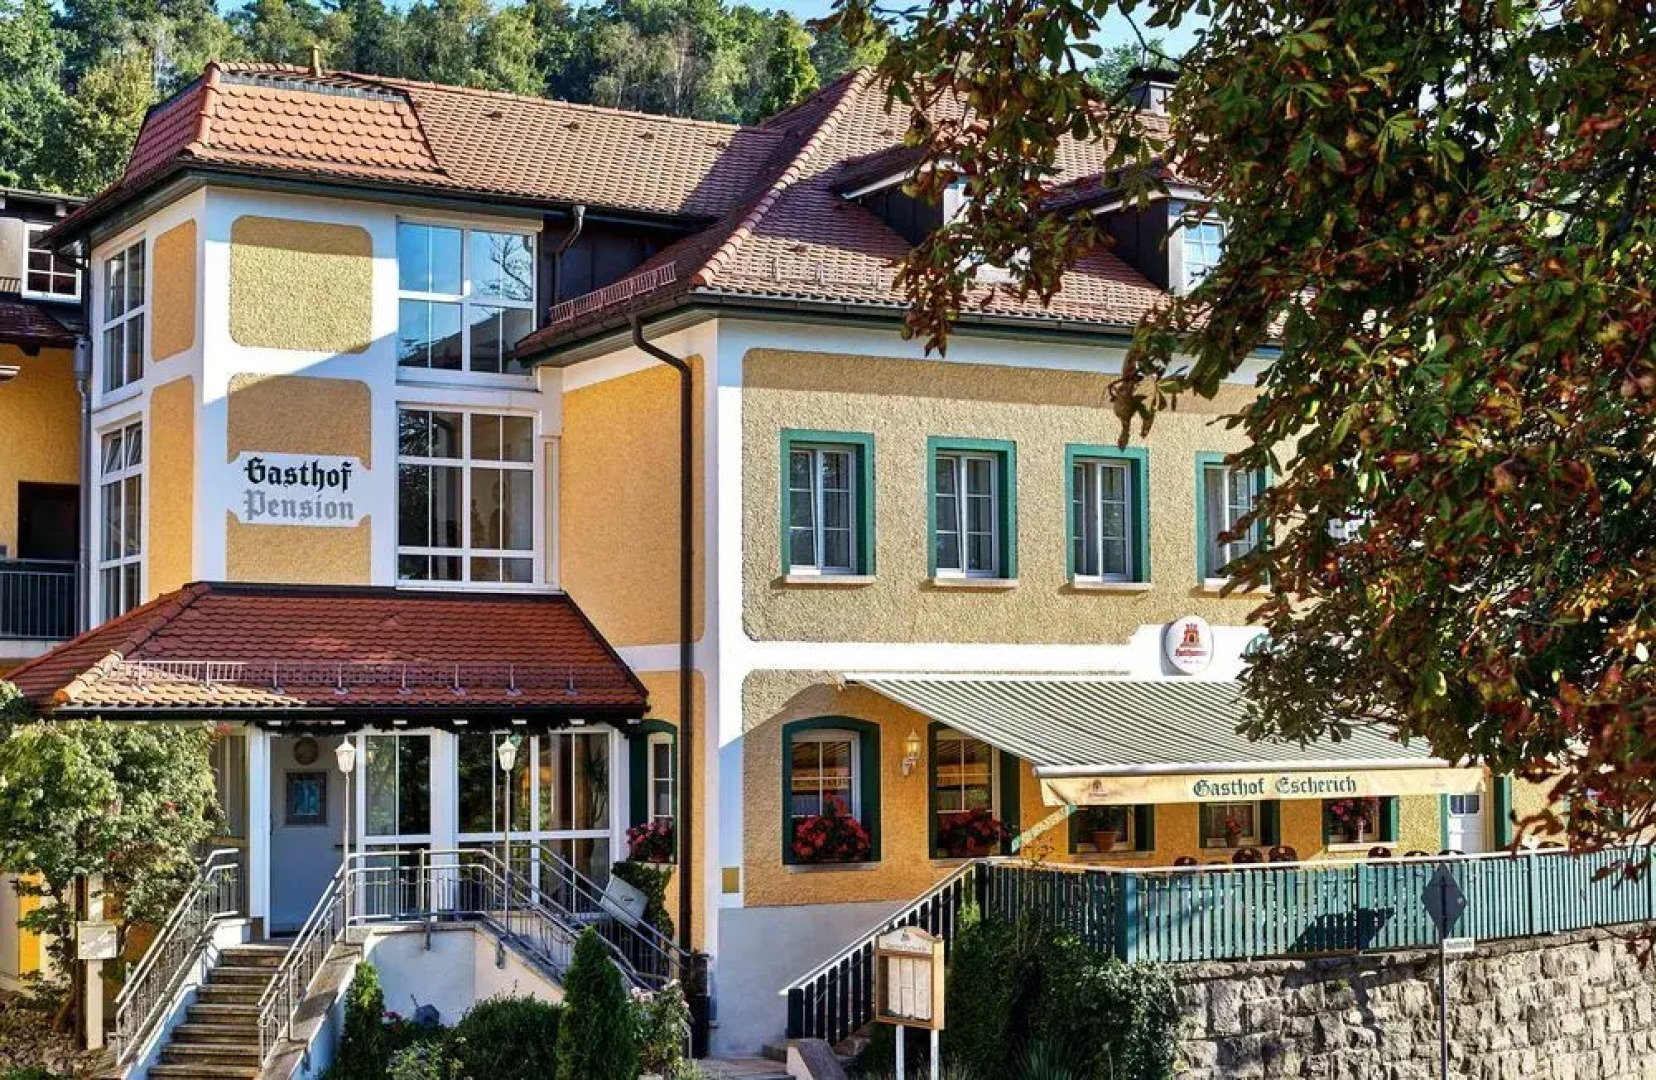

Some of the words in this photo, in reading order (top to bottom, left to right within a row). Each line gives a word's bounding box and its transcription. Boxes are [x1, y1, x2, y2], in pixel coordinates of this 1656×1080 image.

[243, 456, 353, 493] Gasthof
[243, 488, 354, 520] Pension
[1193, 777, 1265, 797] Gasthof
[1275, 776, 1357, 794] Escherich
